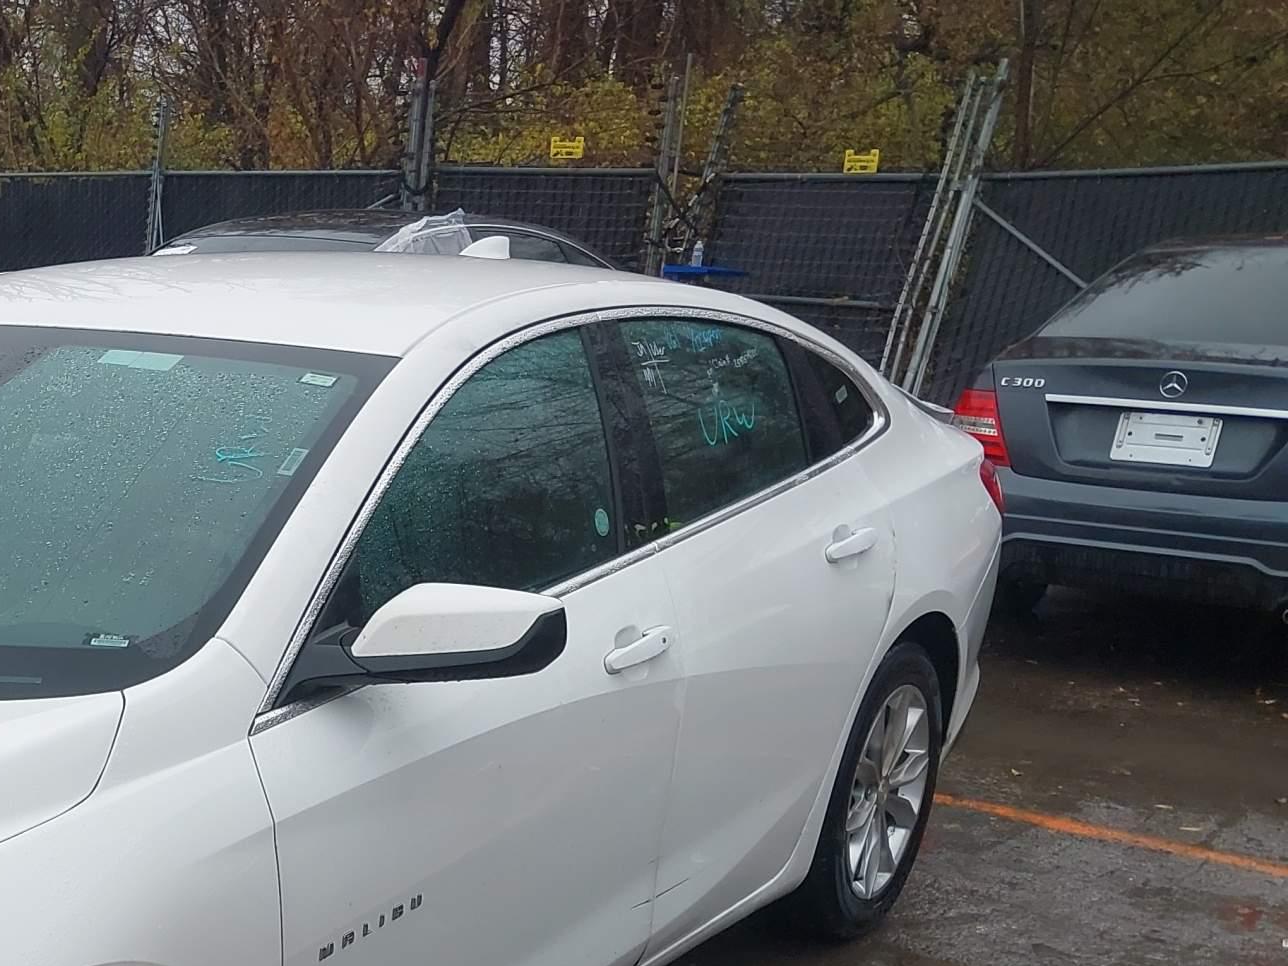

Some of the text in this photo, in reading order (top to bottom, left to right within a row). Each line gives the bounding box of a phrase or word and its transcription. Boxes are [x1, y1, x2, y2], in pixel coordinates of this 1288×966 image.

[1001, 376, 1046, 388] C 300
[318, 893, 423, 962] MALIBU
